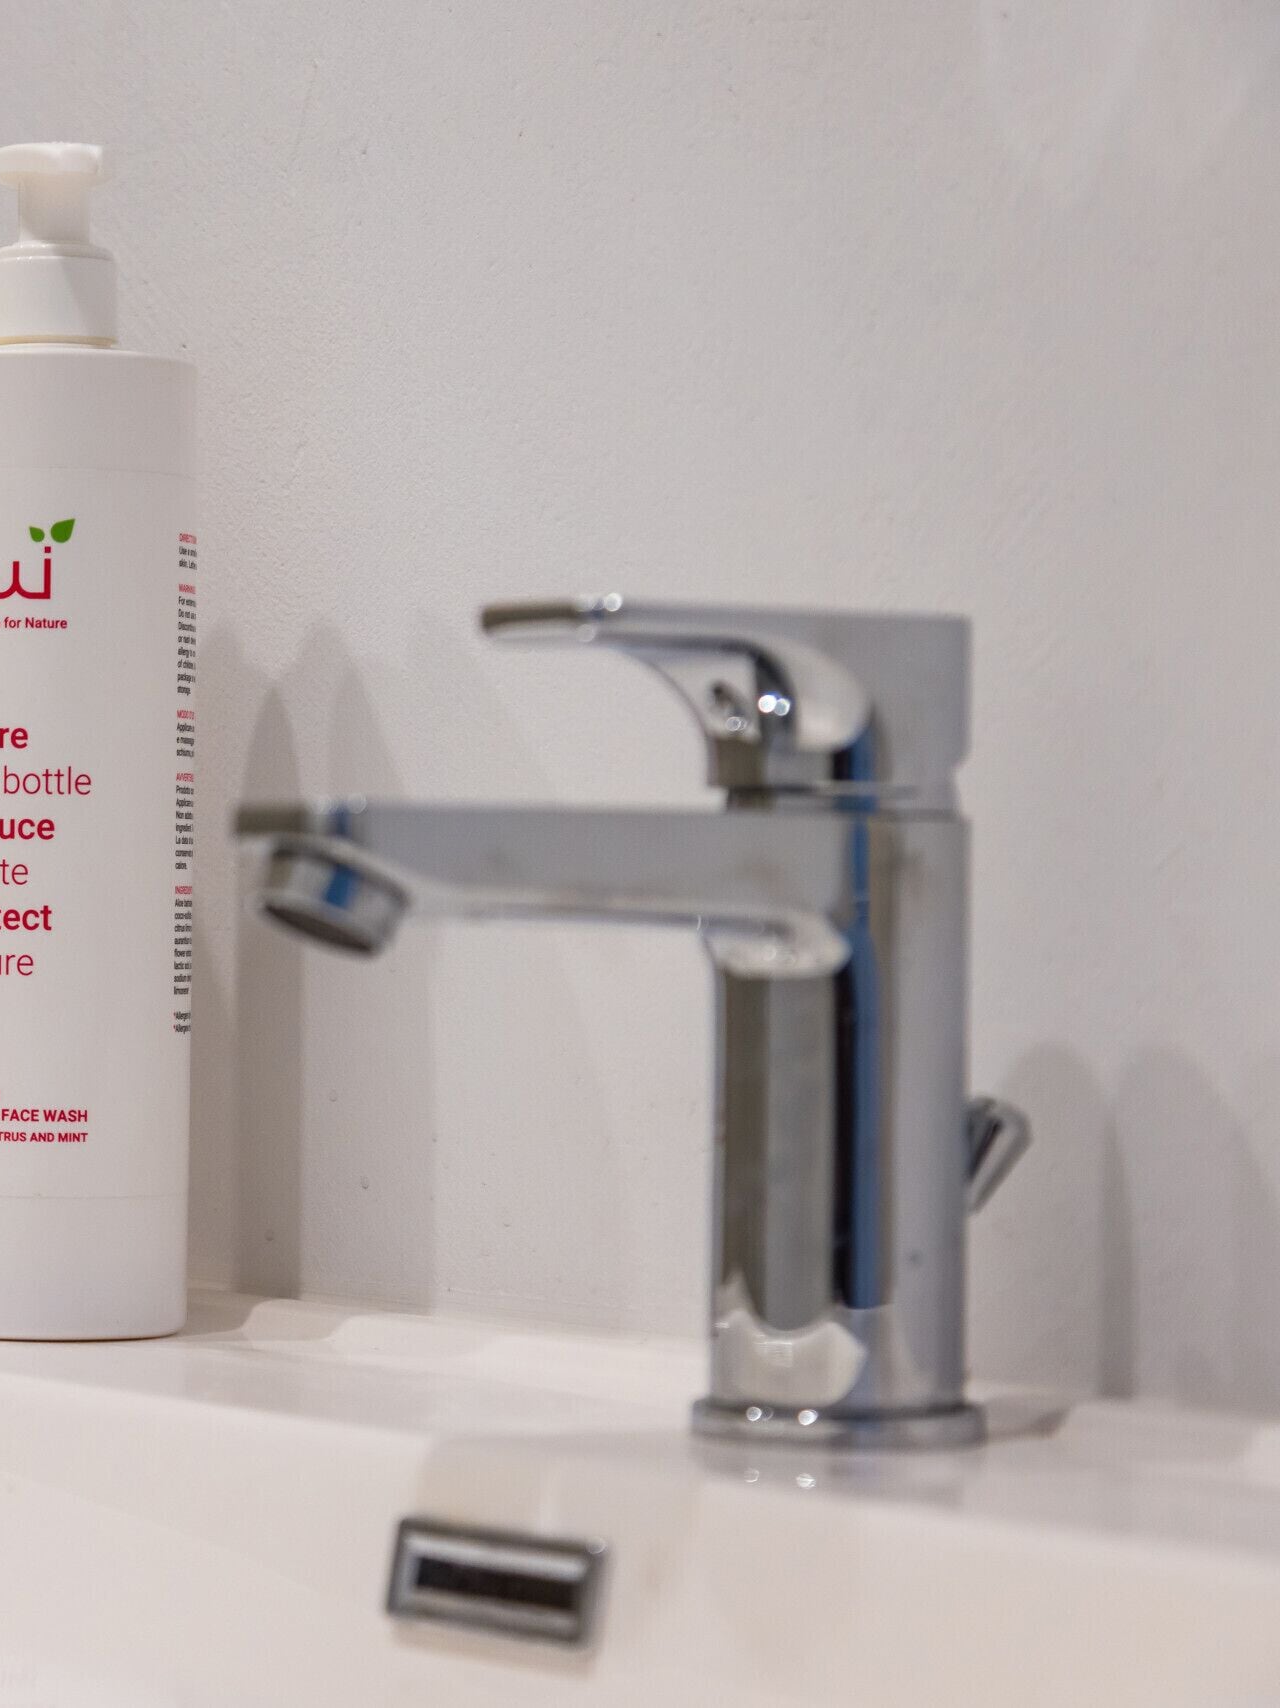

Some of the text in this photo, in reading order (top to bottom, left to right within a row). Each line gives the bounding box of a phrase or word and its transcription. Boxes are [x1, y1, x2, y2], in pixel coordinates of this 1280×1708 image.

[4, 616, 22, 629] for
[24, 616, 68, 629] Nature
[3, 766, 92, 796] bottle
[0, 1108, 40, 1122] FACE
[43, 1109, 88, 1123] WASH
[29, 1132, 55, 1143] AND
[58, 1132, 88, 1143] MINT
